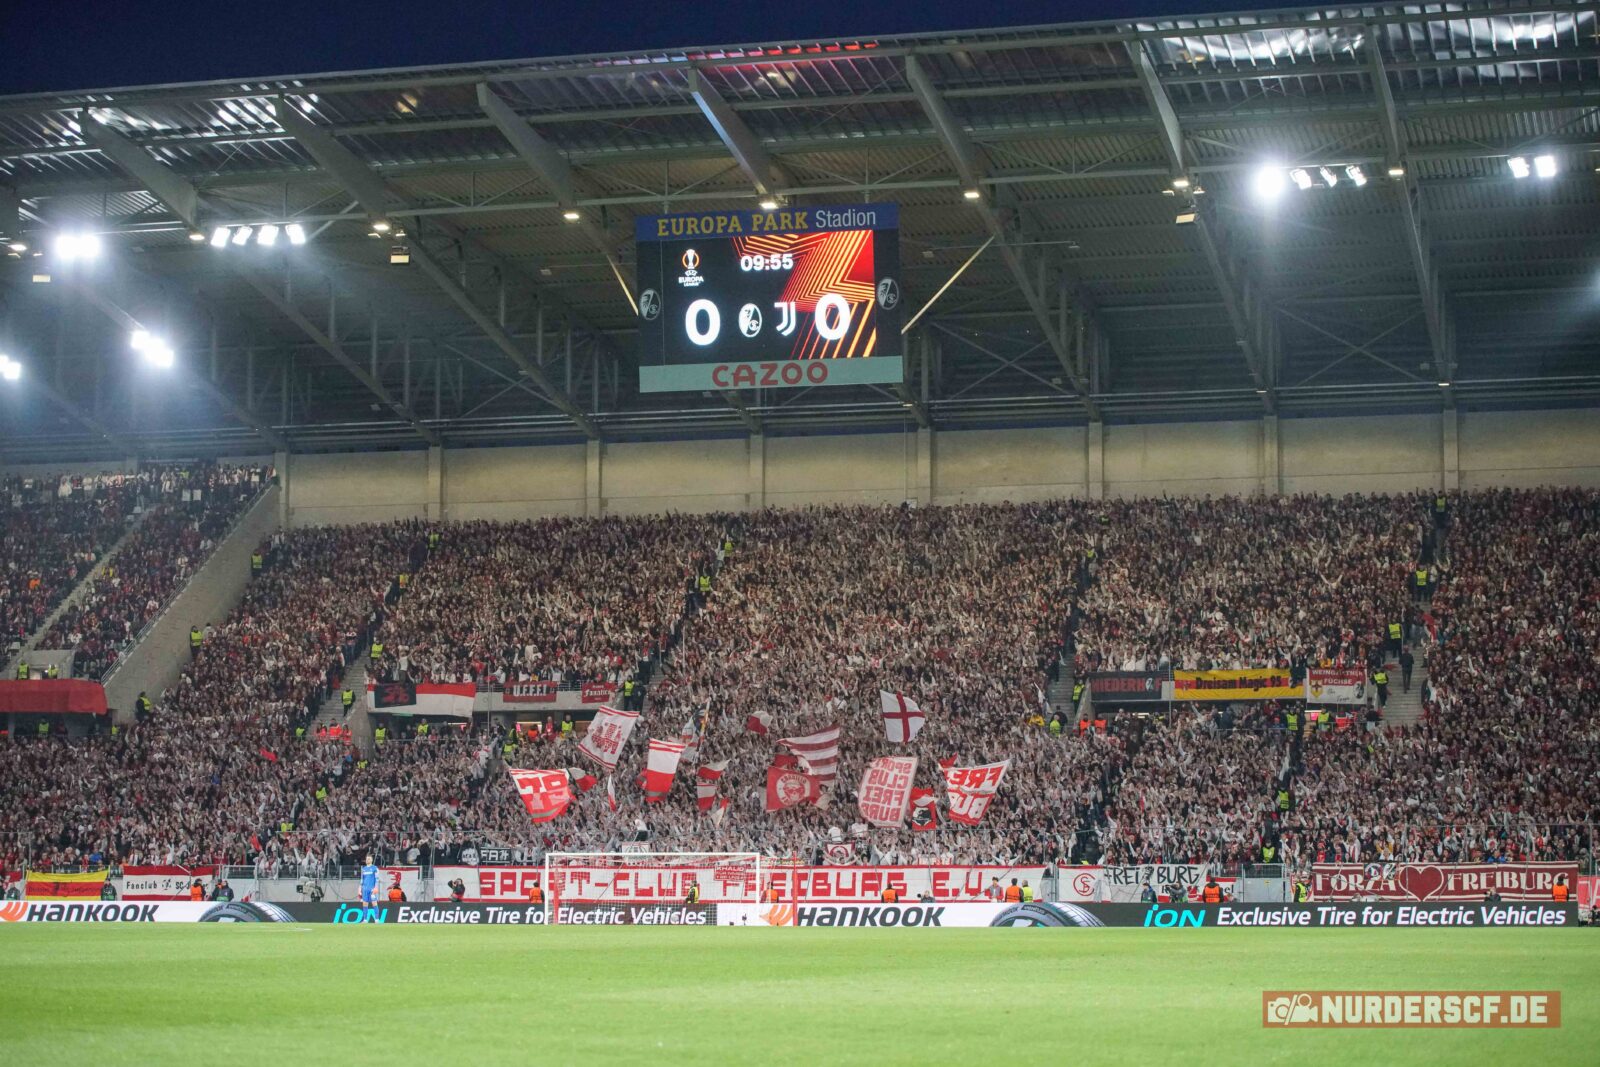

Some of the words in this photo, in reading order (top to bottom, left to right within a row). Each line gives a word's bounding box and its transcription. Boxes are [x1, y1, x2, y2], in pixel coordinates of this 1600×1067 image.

[657, 216, 742, 236] EUROPA
[752, 212, 808, 231] PARK
[815, 209, 876, 228] Stadion
[740, 253, 794, 271] 09:55
[678, 276, 704, 284] EUROPA
[685, 298, 721, 346] 0
[815, 293, 851, 340] 0
[712, 362, 828, 387] CAZOO
[126, 881, 157, 890] Fanclub
[397, 906, 481, 924] Exclusive
[486, 906, 520, 924] Tire
[557, 906, 625, 925] Electric
[632, 907, 707, 925] Vehicles
[1217, 906, 1311, 926] Exclusive
[1316, 906, 1357, 925] Tire
[1361, 906, 1392, 926] for
[1396, 905, 1475, 925] Electric
[1480, 906, 1567, 926] Vehicles
